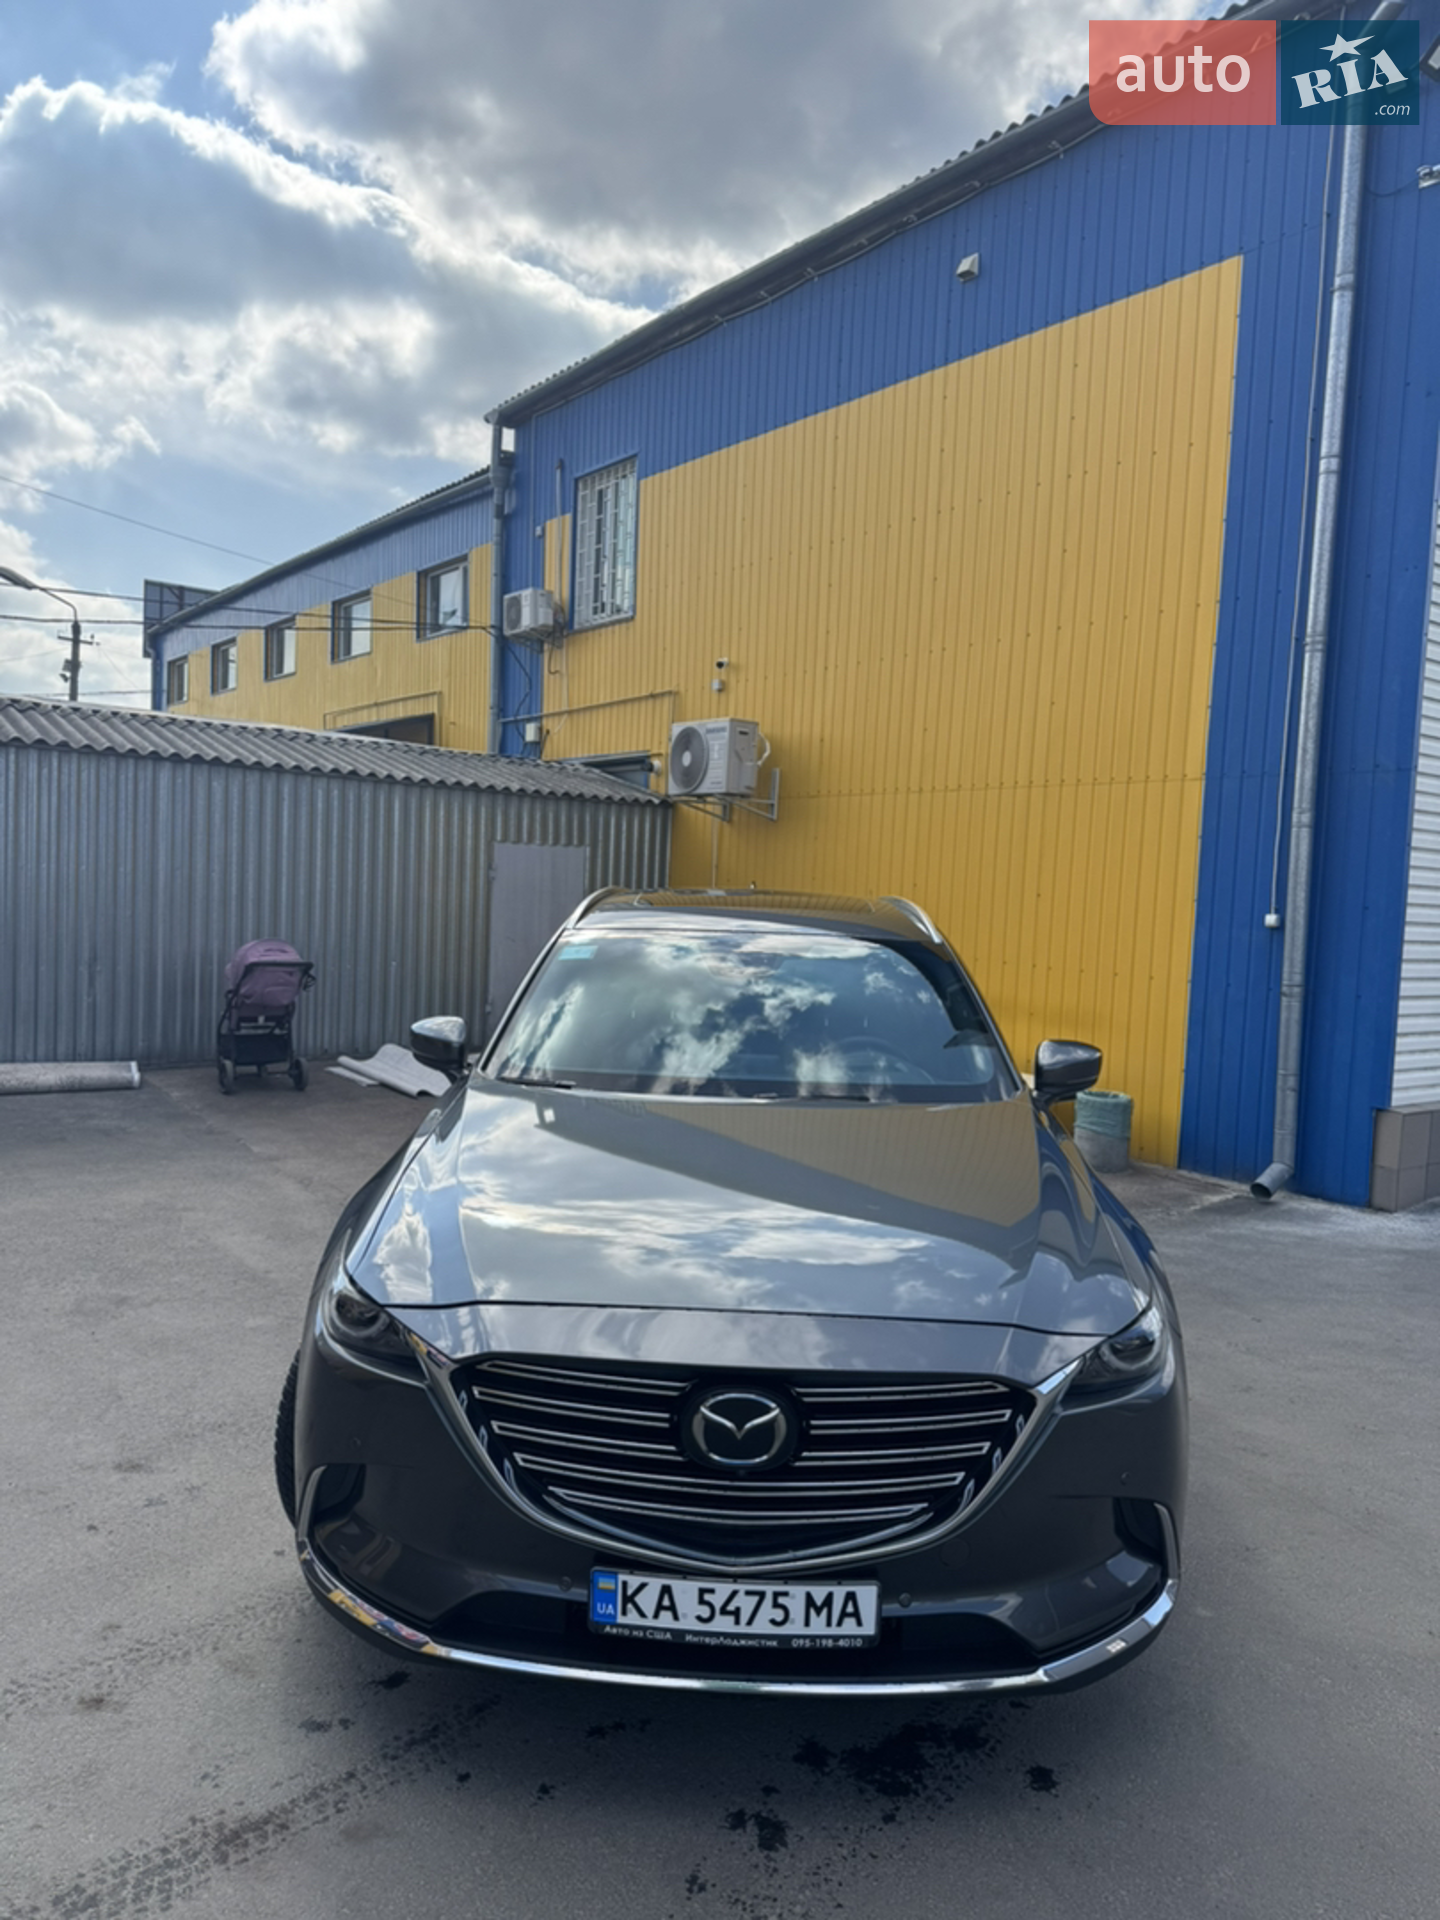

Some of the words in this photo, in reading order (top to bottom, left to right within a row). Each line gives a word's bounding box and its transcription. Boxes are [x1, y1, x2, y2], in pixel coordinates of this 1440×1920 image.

[596, 1602, 615, 1615] UA
[620, 1579, 680, 1622] KA
[694, 1586, 791, 1628] 5475
[803, 1590, 864, 1628] MA
[603, 1625, 630, 1636] Авто
[632, 1629, 644, 1638] из
[645, 1629, 672, 1640] США
